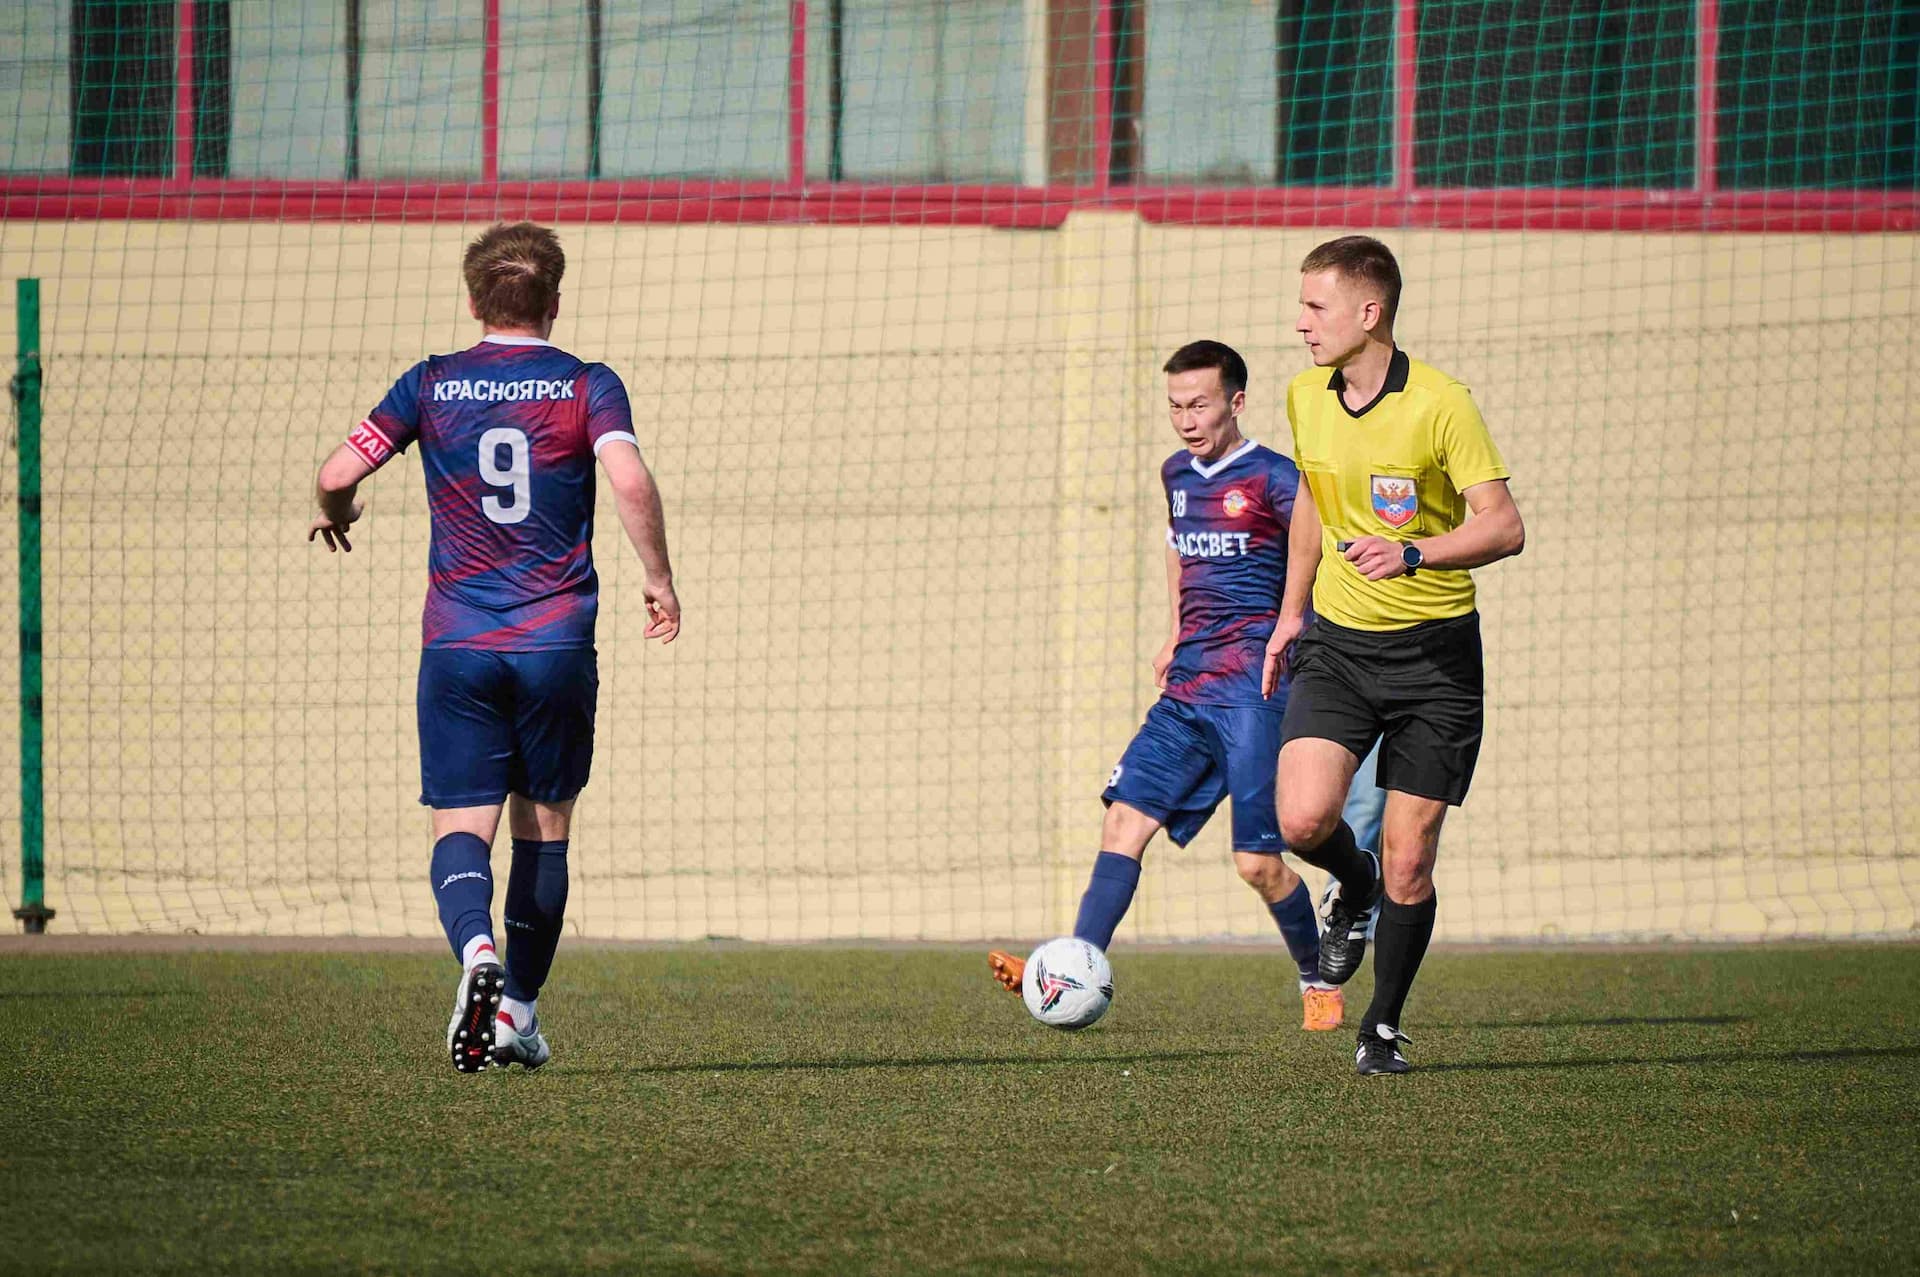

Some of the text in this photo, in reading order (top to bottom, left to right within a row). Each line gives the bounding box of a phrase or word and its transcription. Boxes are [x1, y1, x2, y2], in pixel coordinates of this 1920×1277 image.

[433, 379, 575, 401] КРАСНОЯРСК
[478, 427, 531, 524] 9
[1172, 489, 1186, 517] 28
[1175, 532, 1250, 557] АССВЕТ
